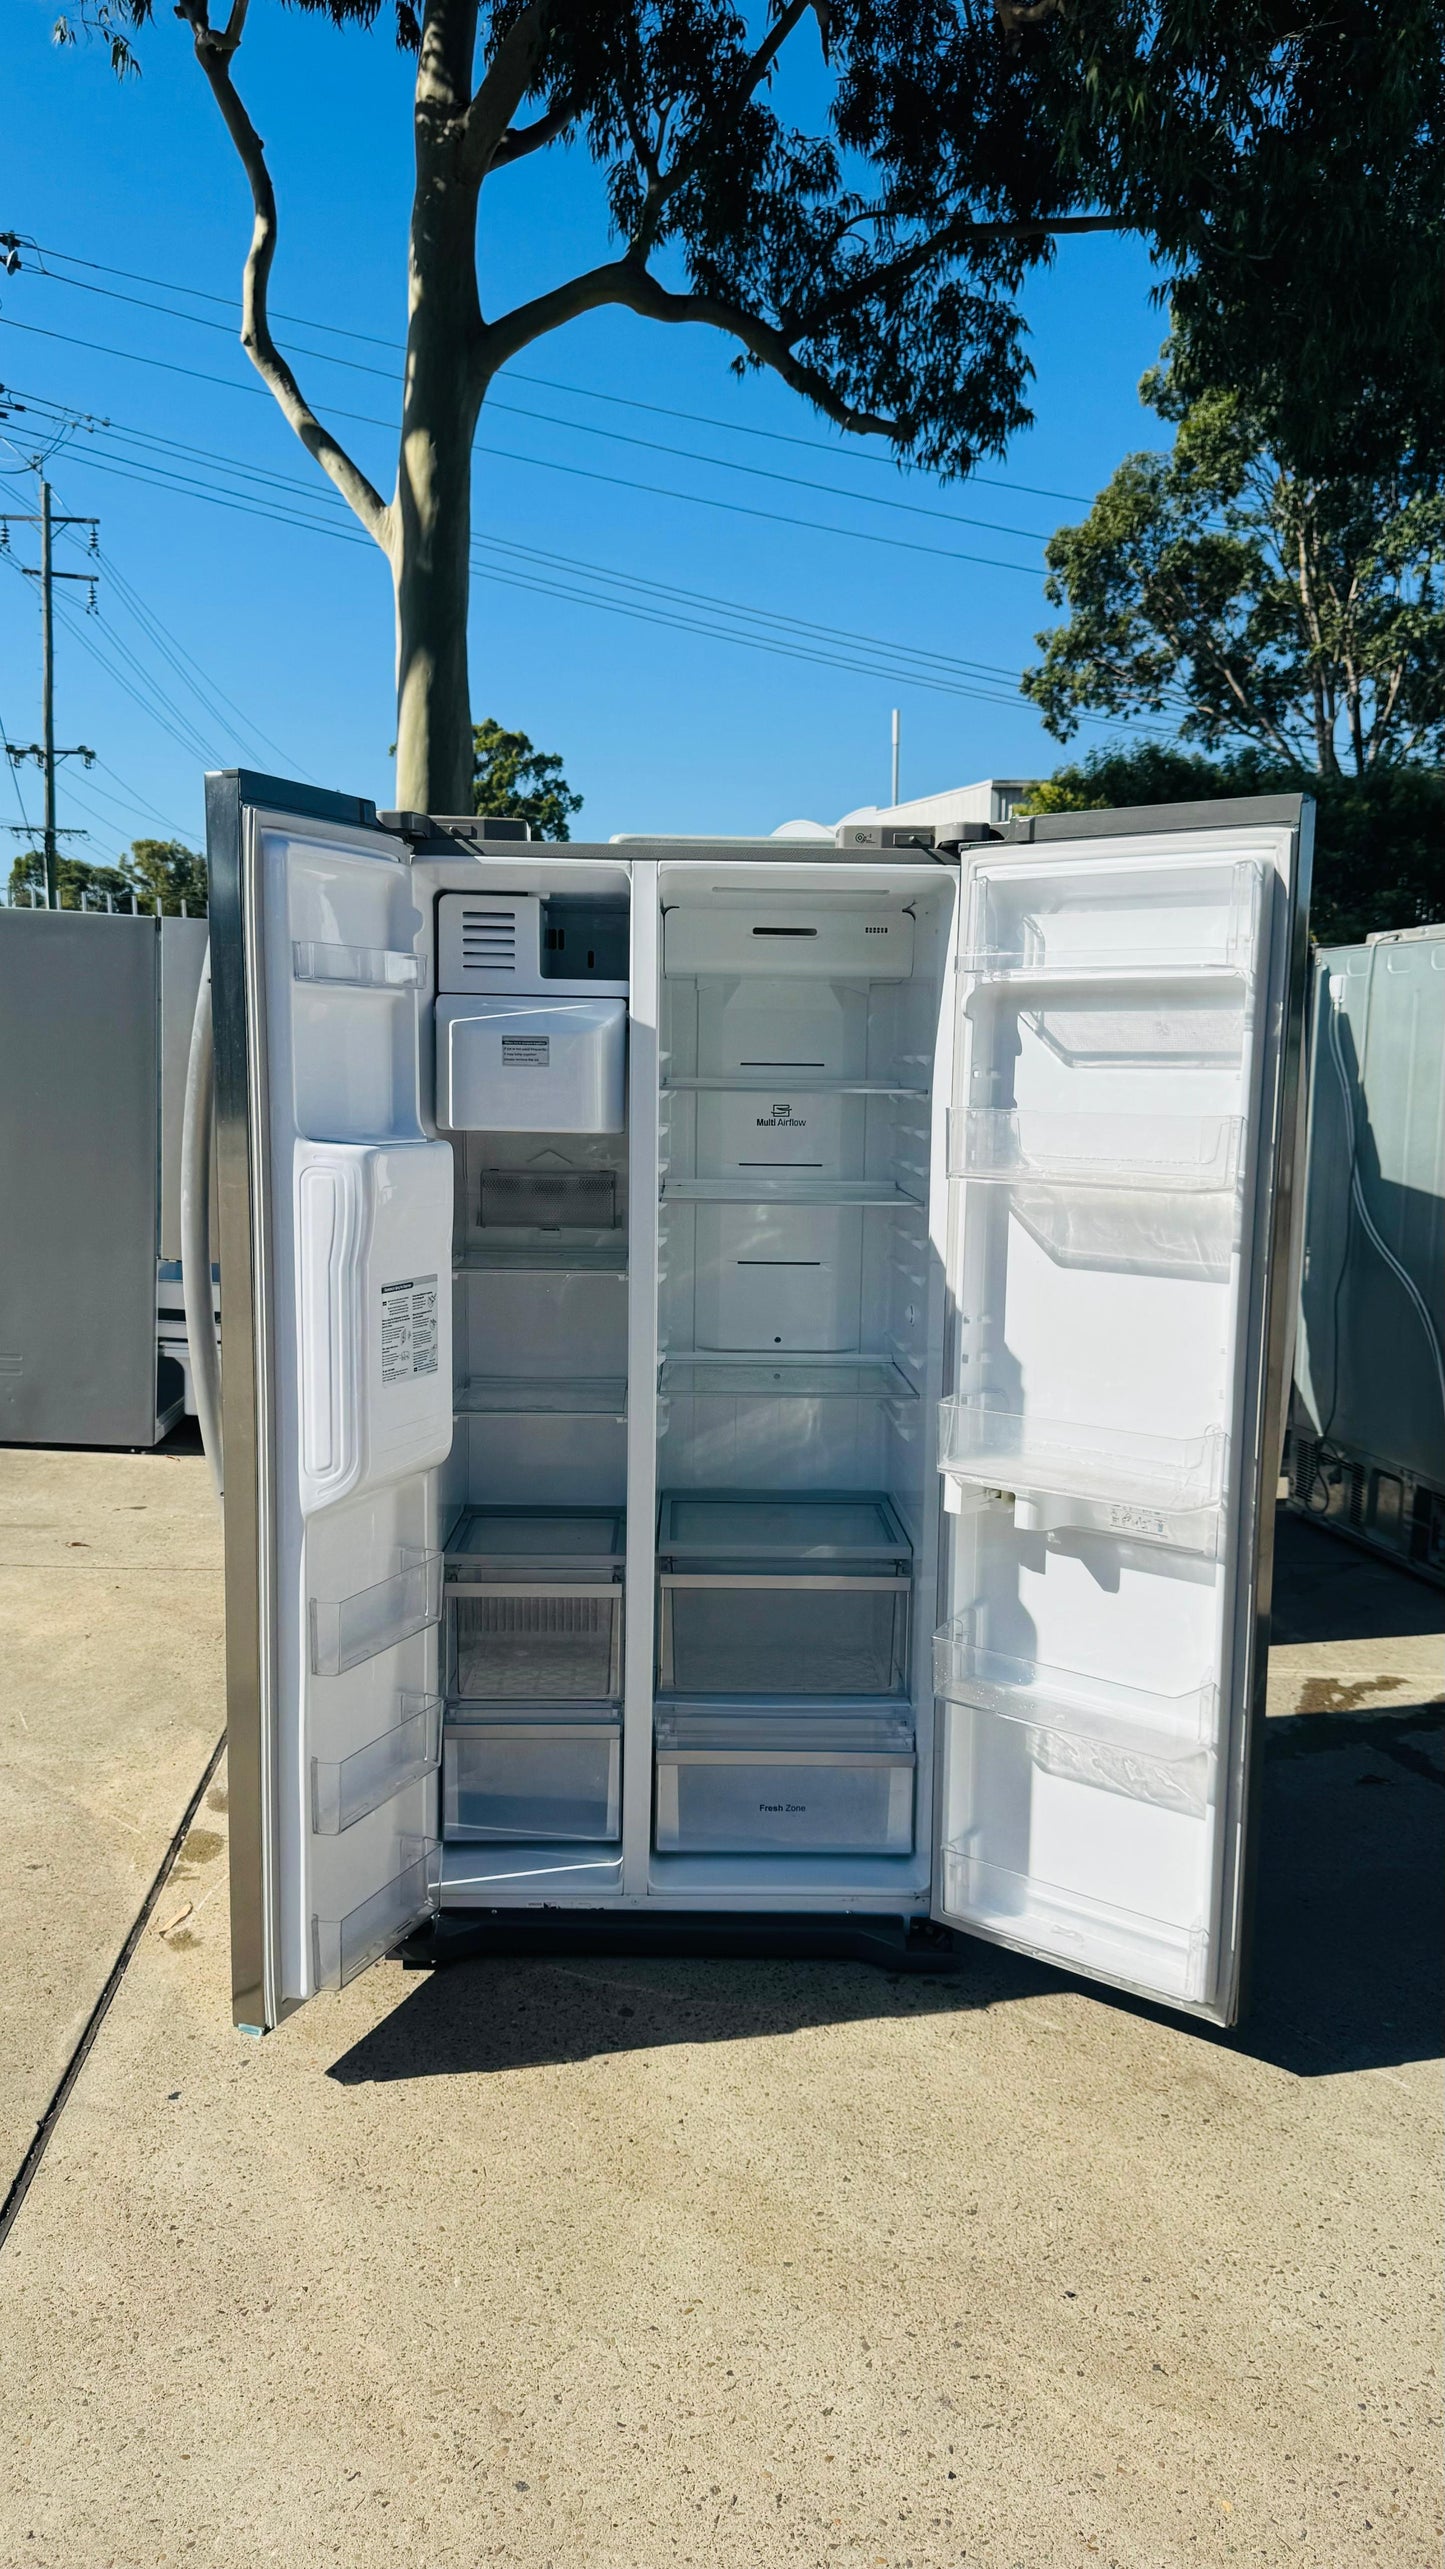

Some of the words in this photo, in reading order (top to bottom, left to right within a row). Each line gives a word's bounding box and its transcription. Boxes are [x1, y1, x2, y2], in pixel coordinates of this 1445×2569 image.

[756, 1118, 776, 1126] Multi
[777, 1118, 807, 1126] Airflow
[759, 1804, 784, 1812] Fresh
[785, 1804, 806, 1812] Zone
